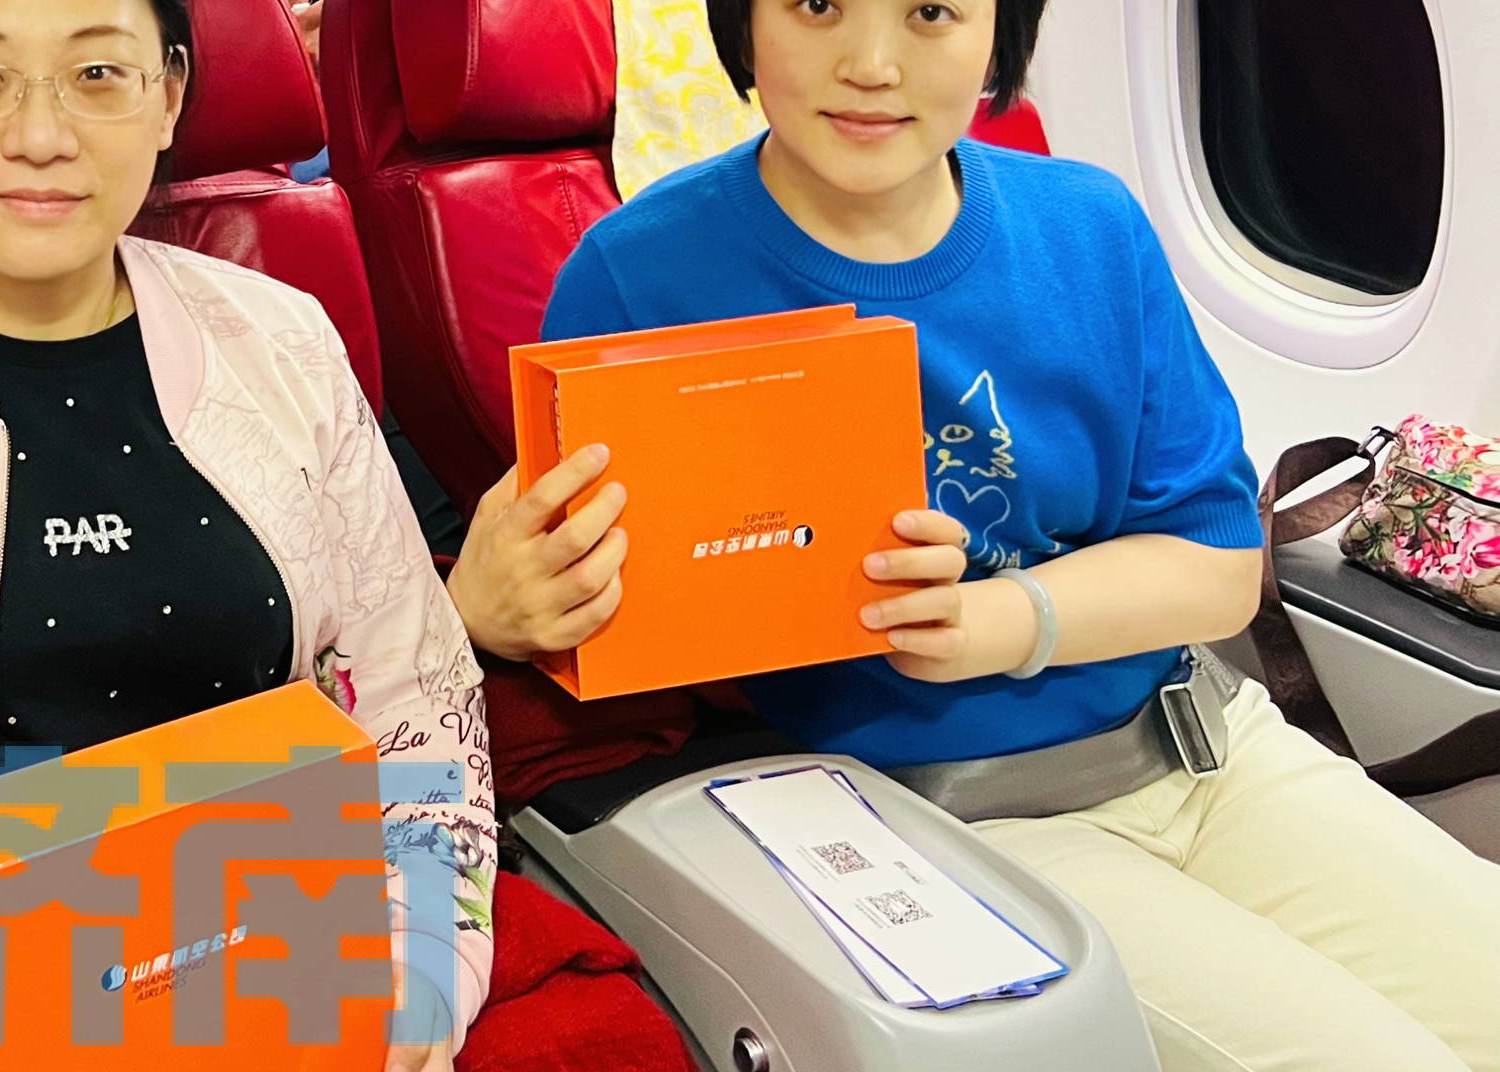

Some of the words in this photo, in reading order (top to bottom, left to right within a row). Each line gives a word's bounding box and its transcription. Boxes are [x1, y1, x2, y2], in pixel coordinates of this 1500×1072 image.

[728, 519, 788, 537] SHANDONG
[744, 510, 786, 524] AIRLINES
[133, 957, 207, 994] SHANDONG
[134, 975, 188, 1005] AIRLINES
